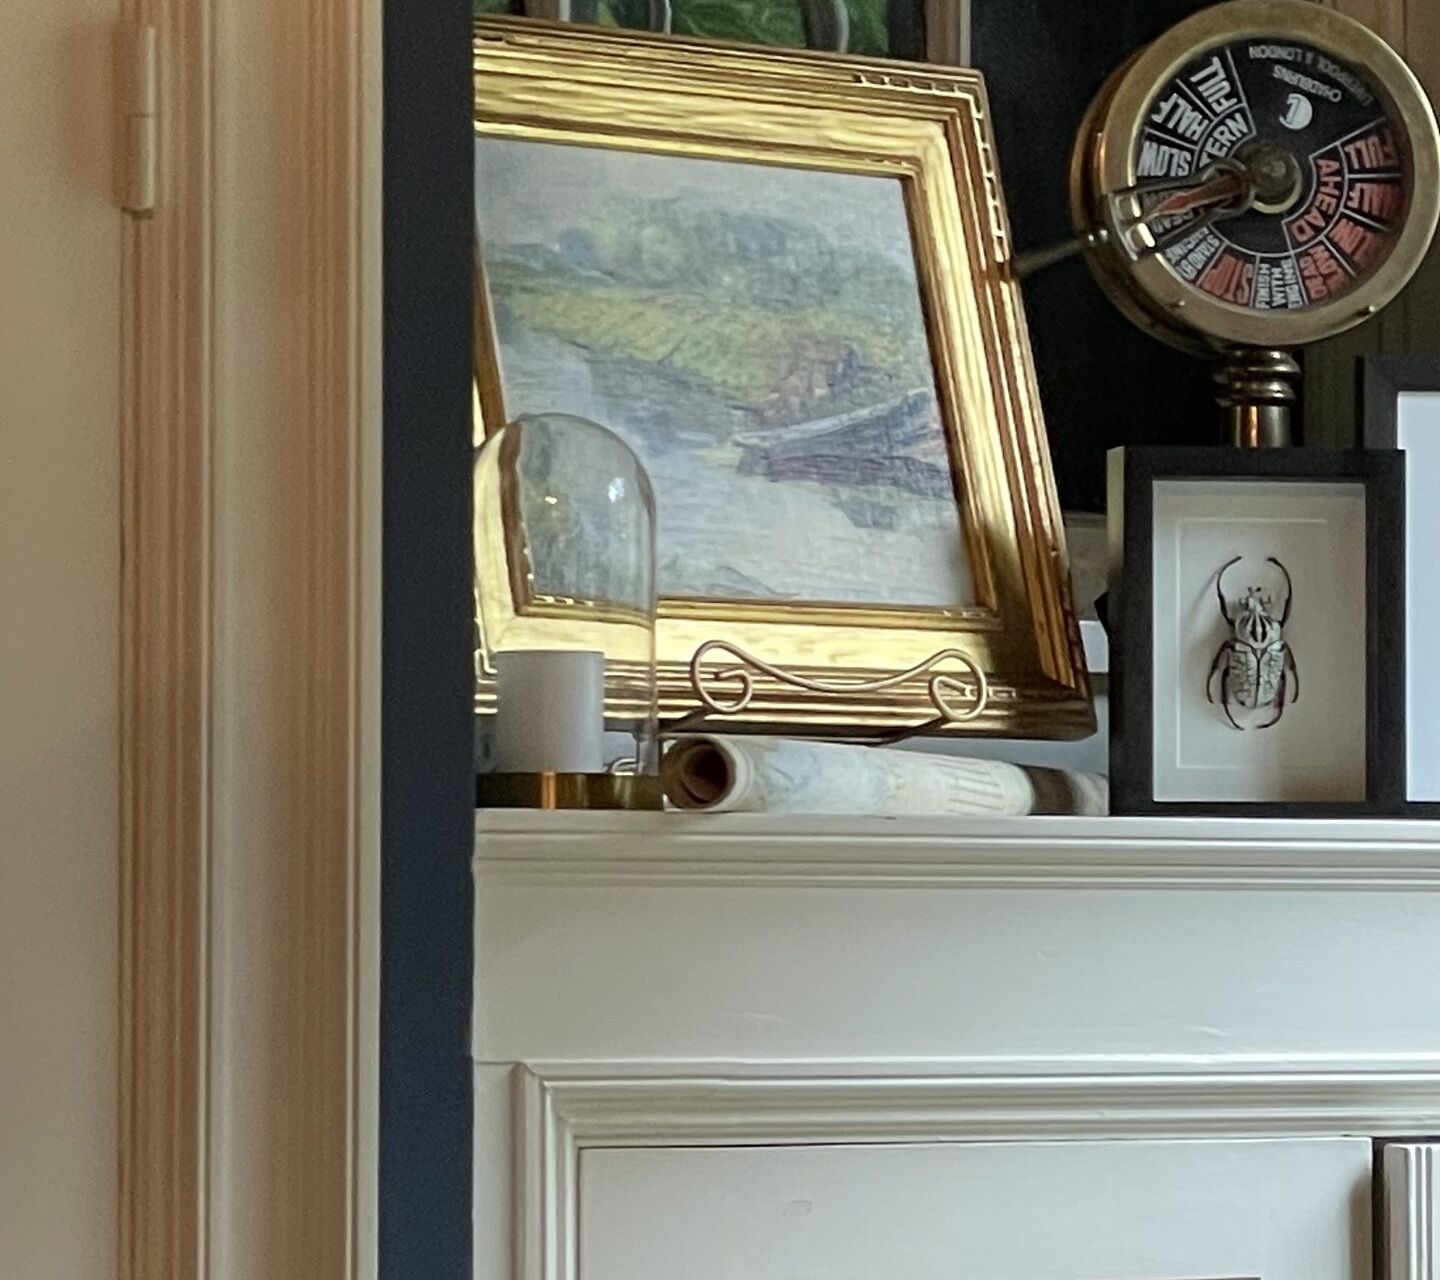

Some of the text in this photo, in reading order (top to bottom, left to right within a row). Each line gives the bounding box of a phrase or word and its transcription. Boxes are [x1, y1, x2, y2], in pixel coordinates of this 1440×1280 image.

[1248, 45, 1302, 61] LONDON
[1190, 56, 1238, 114] FULL
[1151, 93, 1209, 141] HALF
[1137, 141, 1192, 176] SLOW
[1290, 158, 1342, 243] AHEAD
